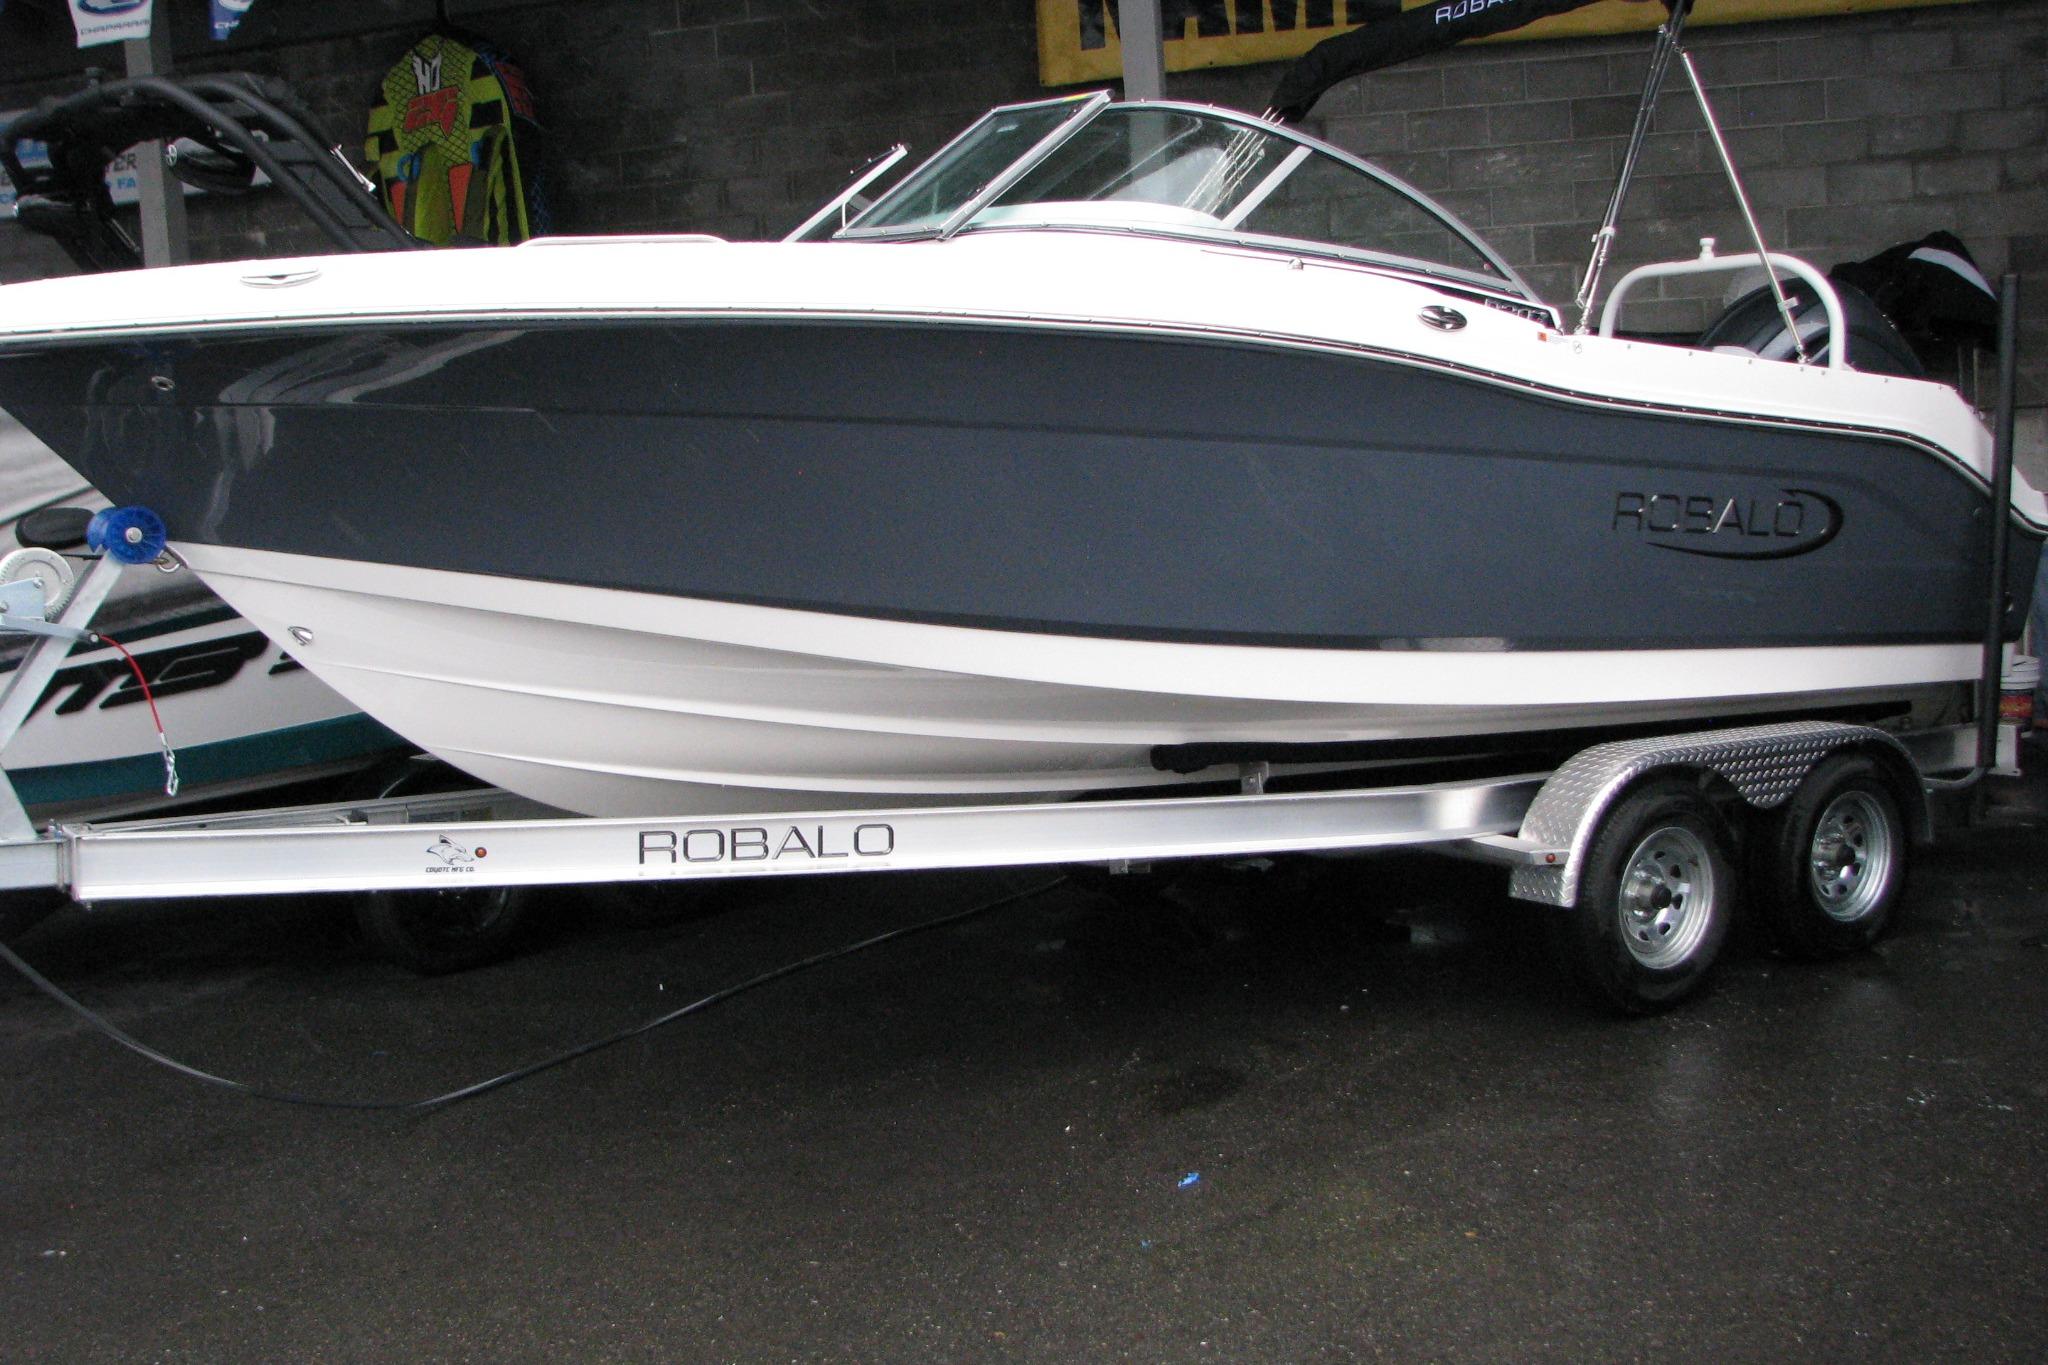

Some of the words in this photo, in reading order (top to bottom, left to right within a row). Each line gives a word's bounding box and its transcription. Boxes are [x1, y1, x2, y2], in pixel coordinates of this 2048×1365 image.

[1612, 491, 1804, 537] ROBALO
[638, 823, 895, 865] ROBALO
[425, 866, 450, 874] COYOTE
